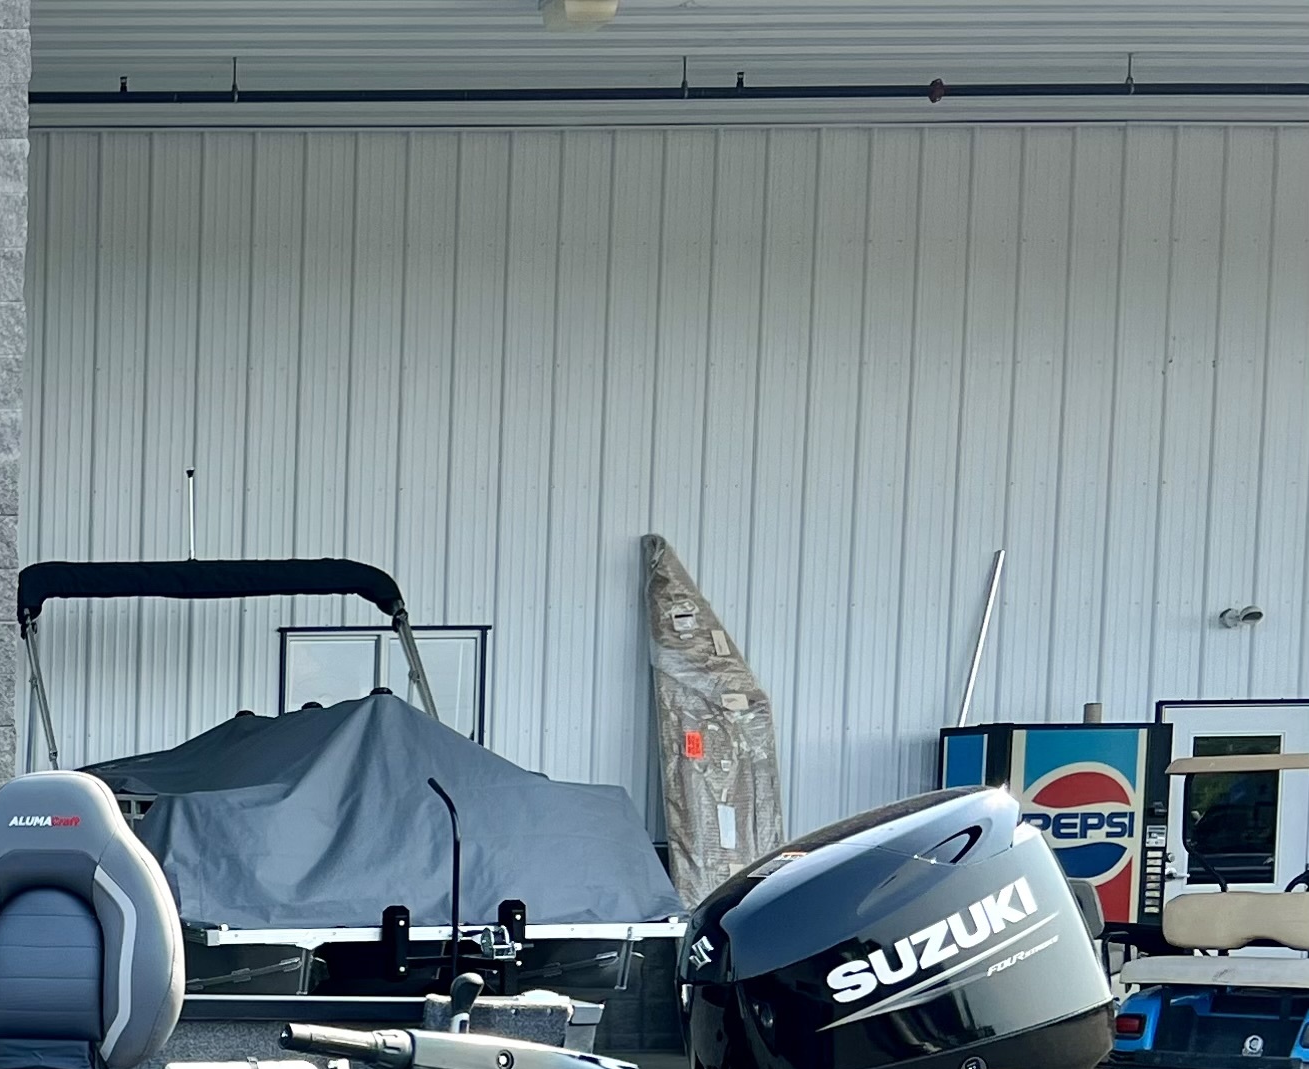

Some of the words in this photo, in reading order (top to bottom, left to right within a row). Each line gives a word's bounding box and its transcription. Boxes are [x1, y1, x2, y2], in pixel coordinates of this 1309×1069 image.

[8, 815, 81, 828] ALUMACraft
[1021, 811, 1135, 840] PEPSI
[826, 875, 1039, 1004] SUZUKI
